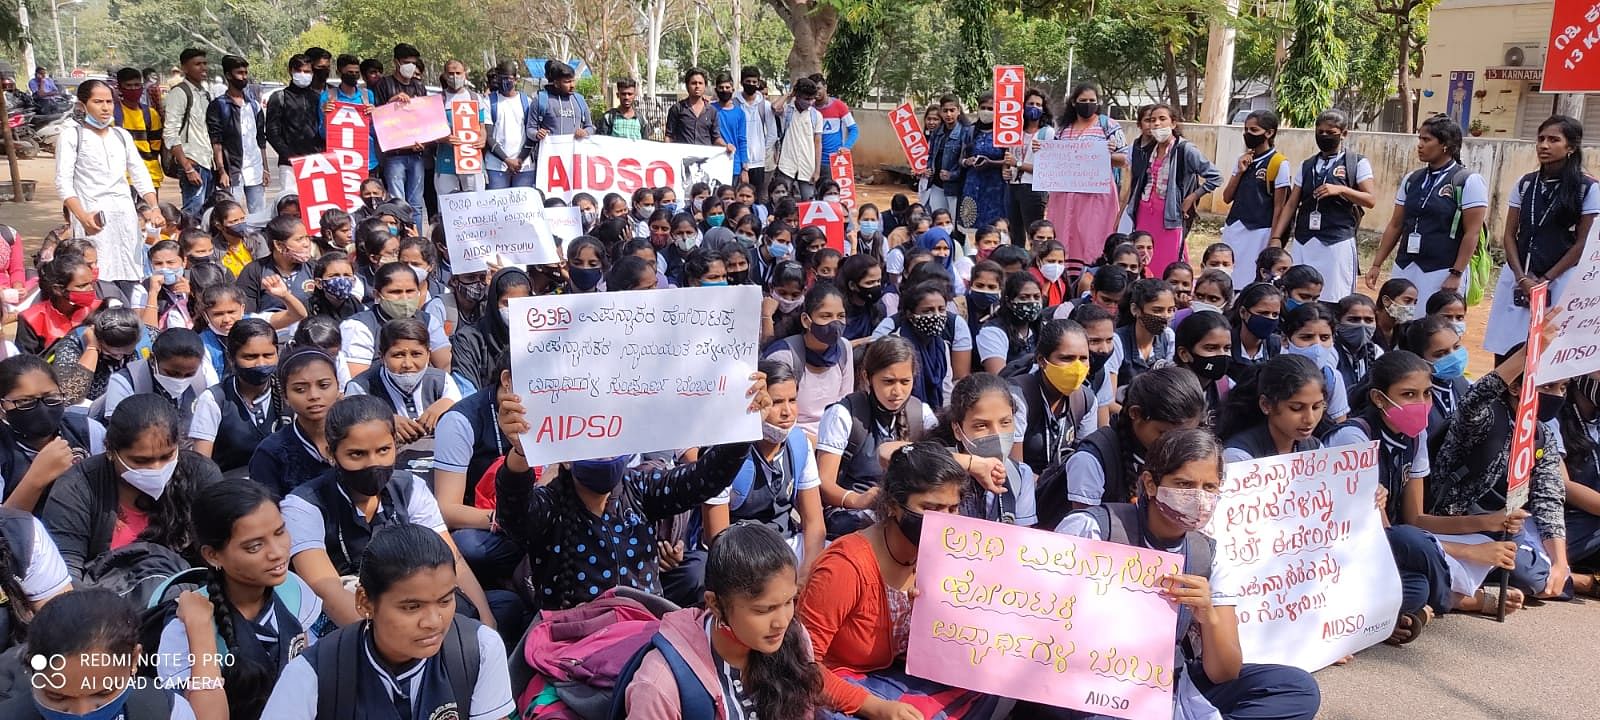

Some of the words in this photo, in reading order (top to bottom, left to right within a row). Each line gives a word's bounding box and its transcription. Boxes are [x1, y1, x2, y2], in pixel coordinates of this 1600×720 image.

[1564, 49, 1583, 70] 13
[1488, 70, 1497, 79] 13
[997, 70, 1022, 145] AIDSO
[456, 103, 480, 170] AIDSO
[895, 108, 929, 170] AIDSO
[548, 154, 675, 193] AIDSO
[464, 245, 491, 258] AIDSO
[1550, 345, 1597, 365] AIDSO
[1513, 295, 1544, 480] AIDSO
[536, 416, 622, 443] AIDSO
[1322, 614, 1365, 639] AIDSO
[1085, 691, 1129, 709] AIDSO
